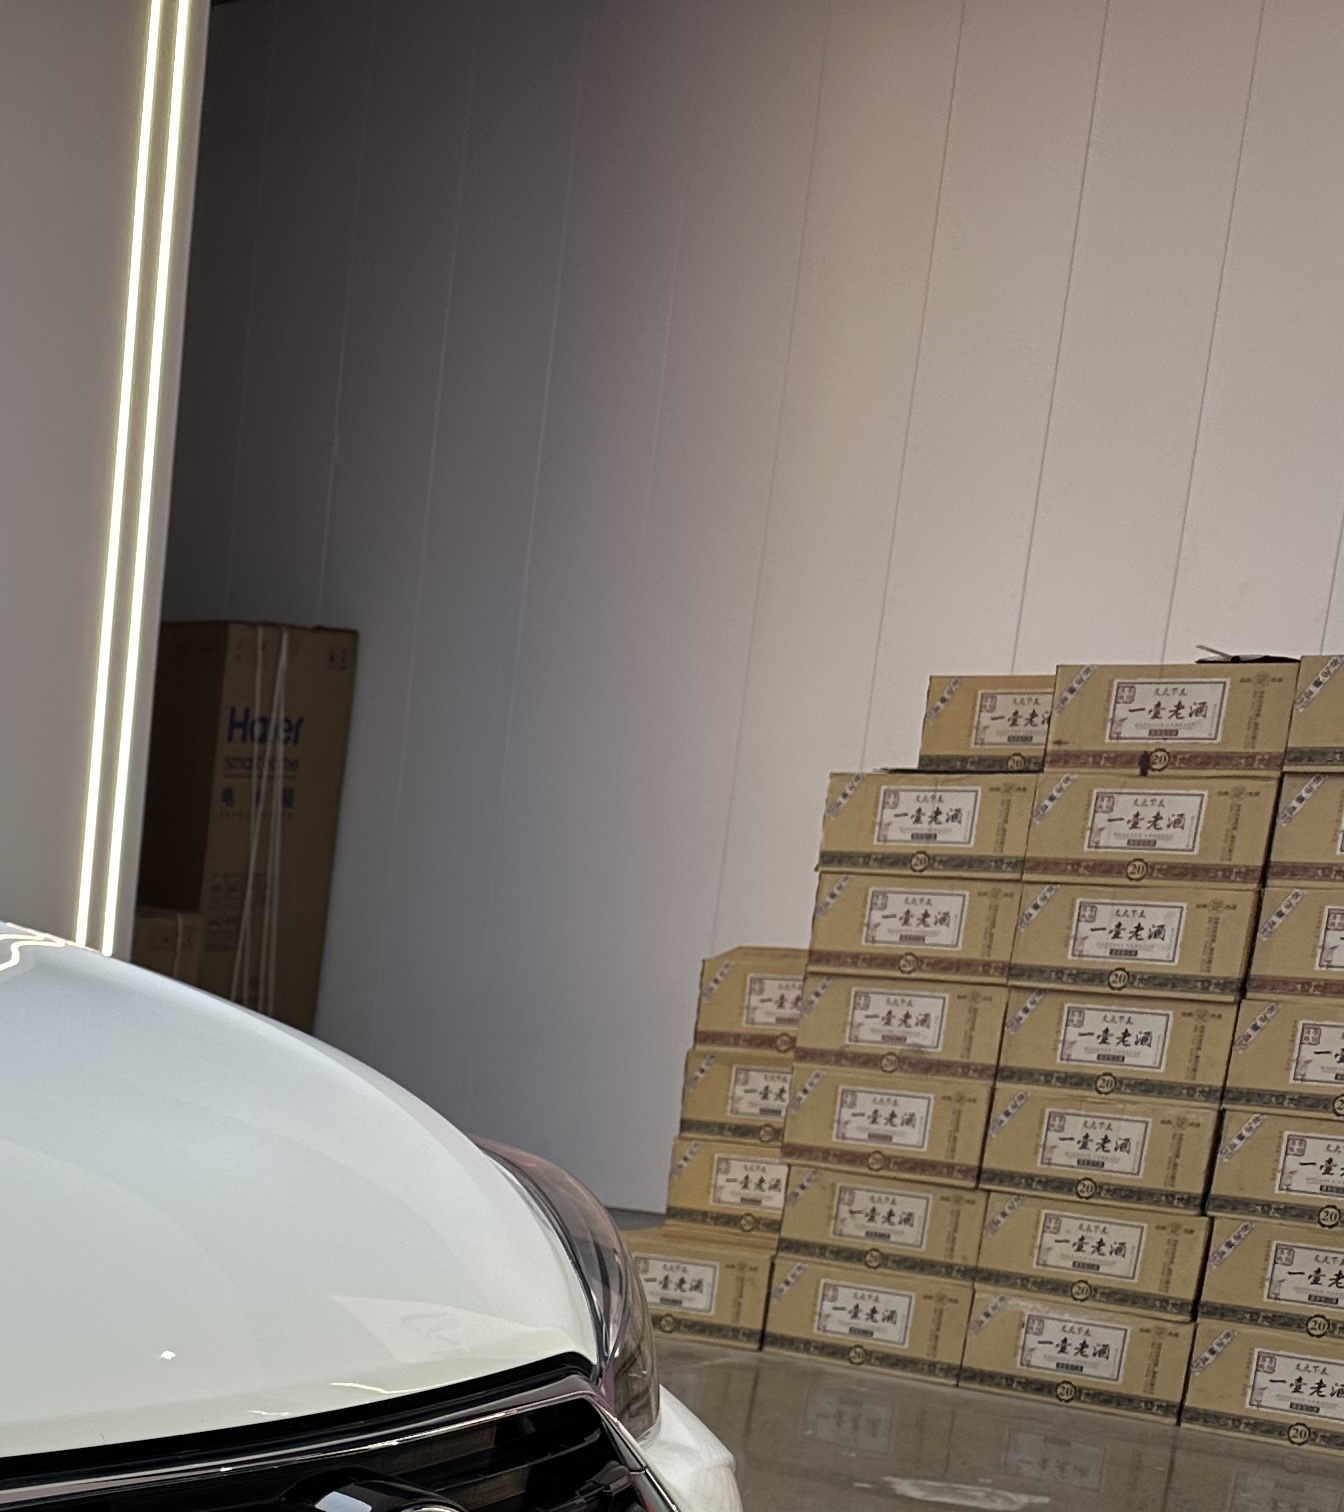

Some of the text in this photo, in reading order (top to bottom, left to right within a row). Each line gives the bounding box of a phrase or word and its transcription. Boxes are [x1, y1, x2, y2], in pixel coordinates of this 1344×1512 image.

[227, 706, 305, 746] Haer
[1150, 753, 1167, 765] 20
[912, 855, 927, 867] 20
[1128, 863, 1145, 875] 20
[1111, 972, 1127, 985] 20
[1098, 1076, 1114, 1090] 20
[1078, 1181, 1094, 1195] 20
[1322, 1211, 1338, 1223] 20
[1073, 1283, 1089, 1297] 20
[1309, 1320, 1325, 1333] 20
[1057, 1384, 1072, 1398] 20
[1293, 1427, 1308, 1441] 20
